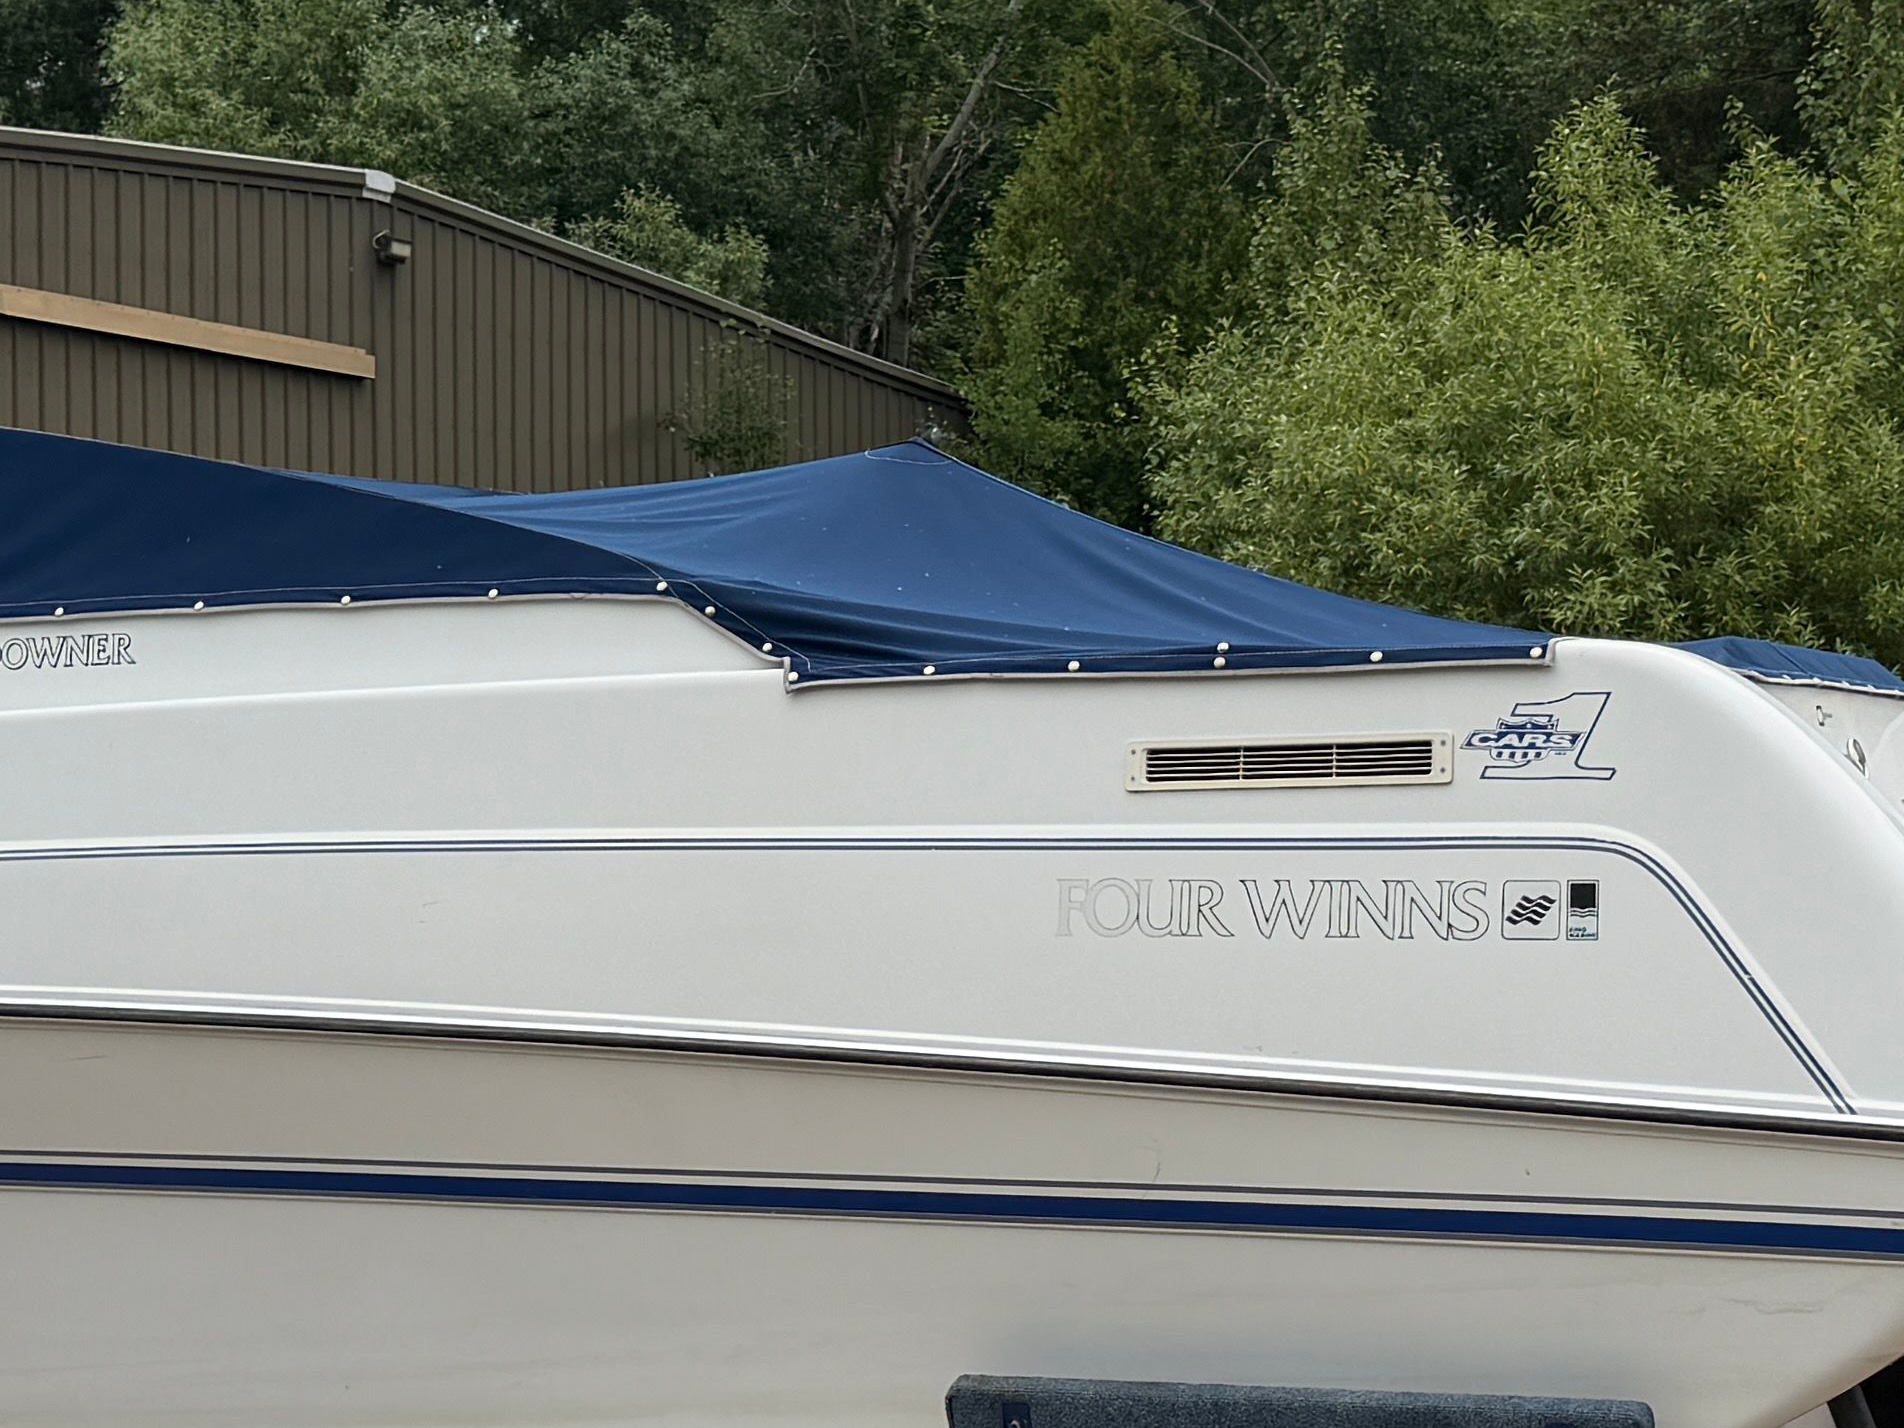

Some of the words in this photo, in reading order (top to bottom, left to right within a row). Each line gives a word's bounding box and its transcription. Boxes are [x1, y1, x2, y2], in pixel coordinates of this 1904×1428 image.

[1469, 732, 1576, 748] CARS
[1053, 876, 1236, 939] FOUR
[1239, 878, 1491, 941] WINNS
